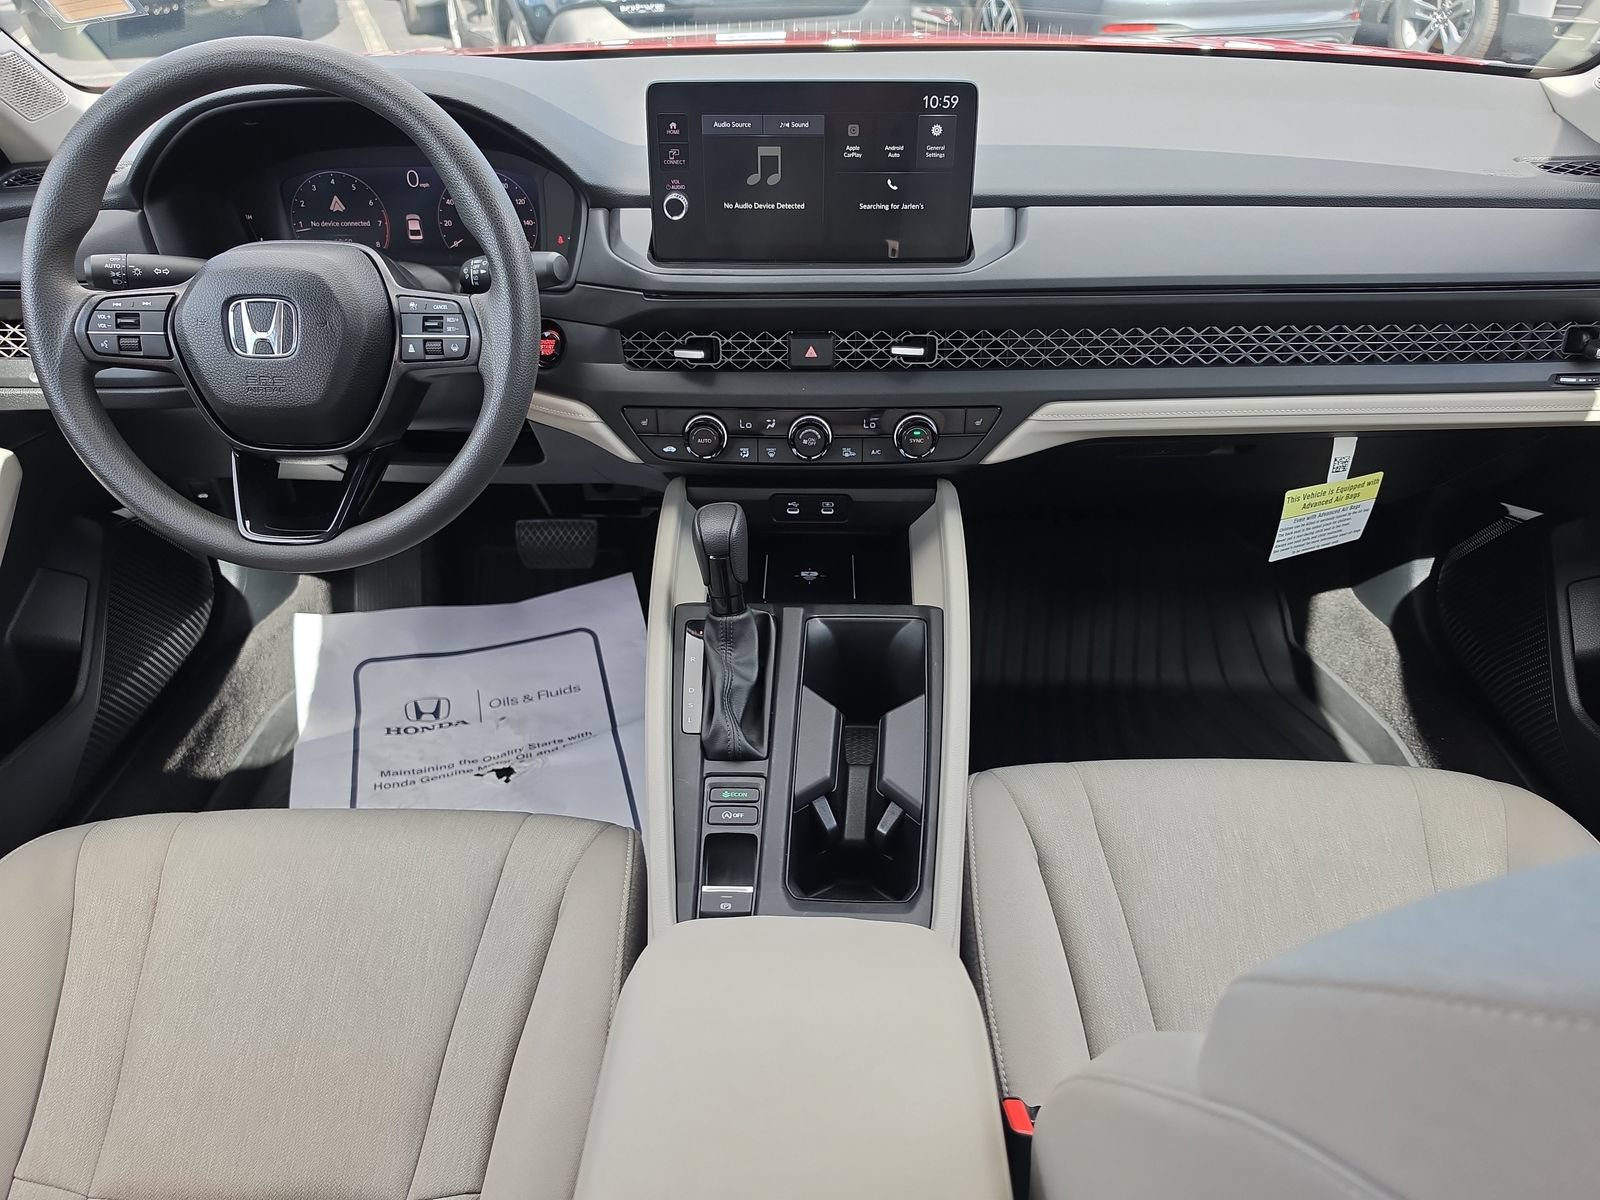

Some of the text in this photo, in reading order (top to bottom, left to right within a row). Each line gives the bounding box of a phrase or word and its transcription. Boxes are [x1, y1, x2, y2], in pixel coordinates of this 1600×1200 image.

[922, 95, 959, 109] 10:59
[406, 169, 419, 188] 0
[859, 202, 890, 210] Searching
[890, 202, 900, 210] for
[443, 219, 452, 227] 20
[1287, 478, 1380, 504] This Vehicle is Equipped with
[1301, 491, 1361, 510] Advanced Air Bags
[1317, 508, 1341, 518] Advanced
[489, 684, 582, 709] Oils & Fluids
[384, 719, 470, 736] HONDA
[380, 762, 455, 778] Maintaining
[459, 757, 479, 766] the
[482, 746, 525, 763] Quality
[528, 737, 564, 750] Starts
[567, 731, 593, 742] with
[373, 779, 417, 791] Honda
[420, 767, 474, 783] Genuine
[516, 752, 535, 761] Oil
[536, 747, 559, 757] and
